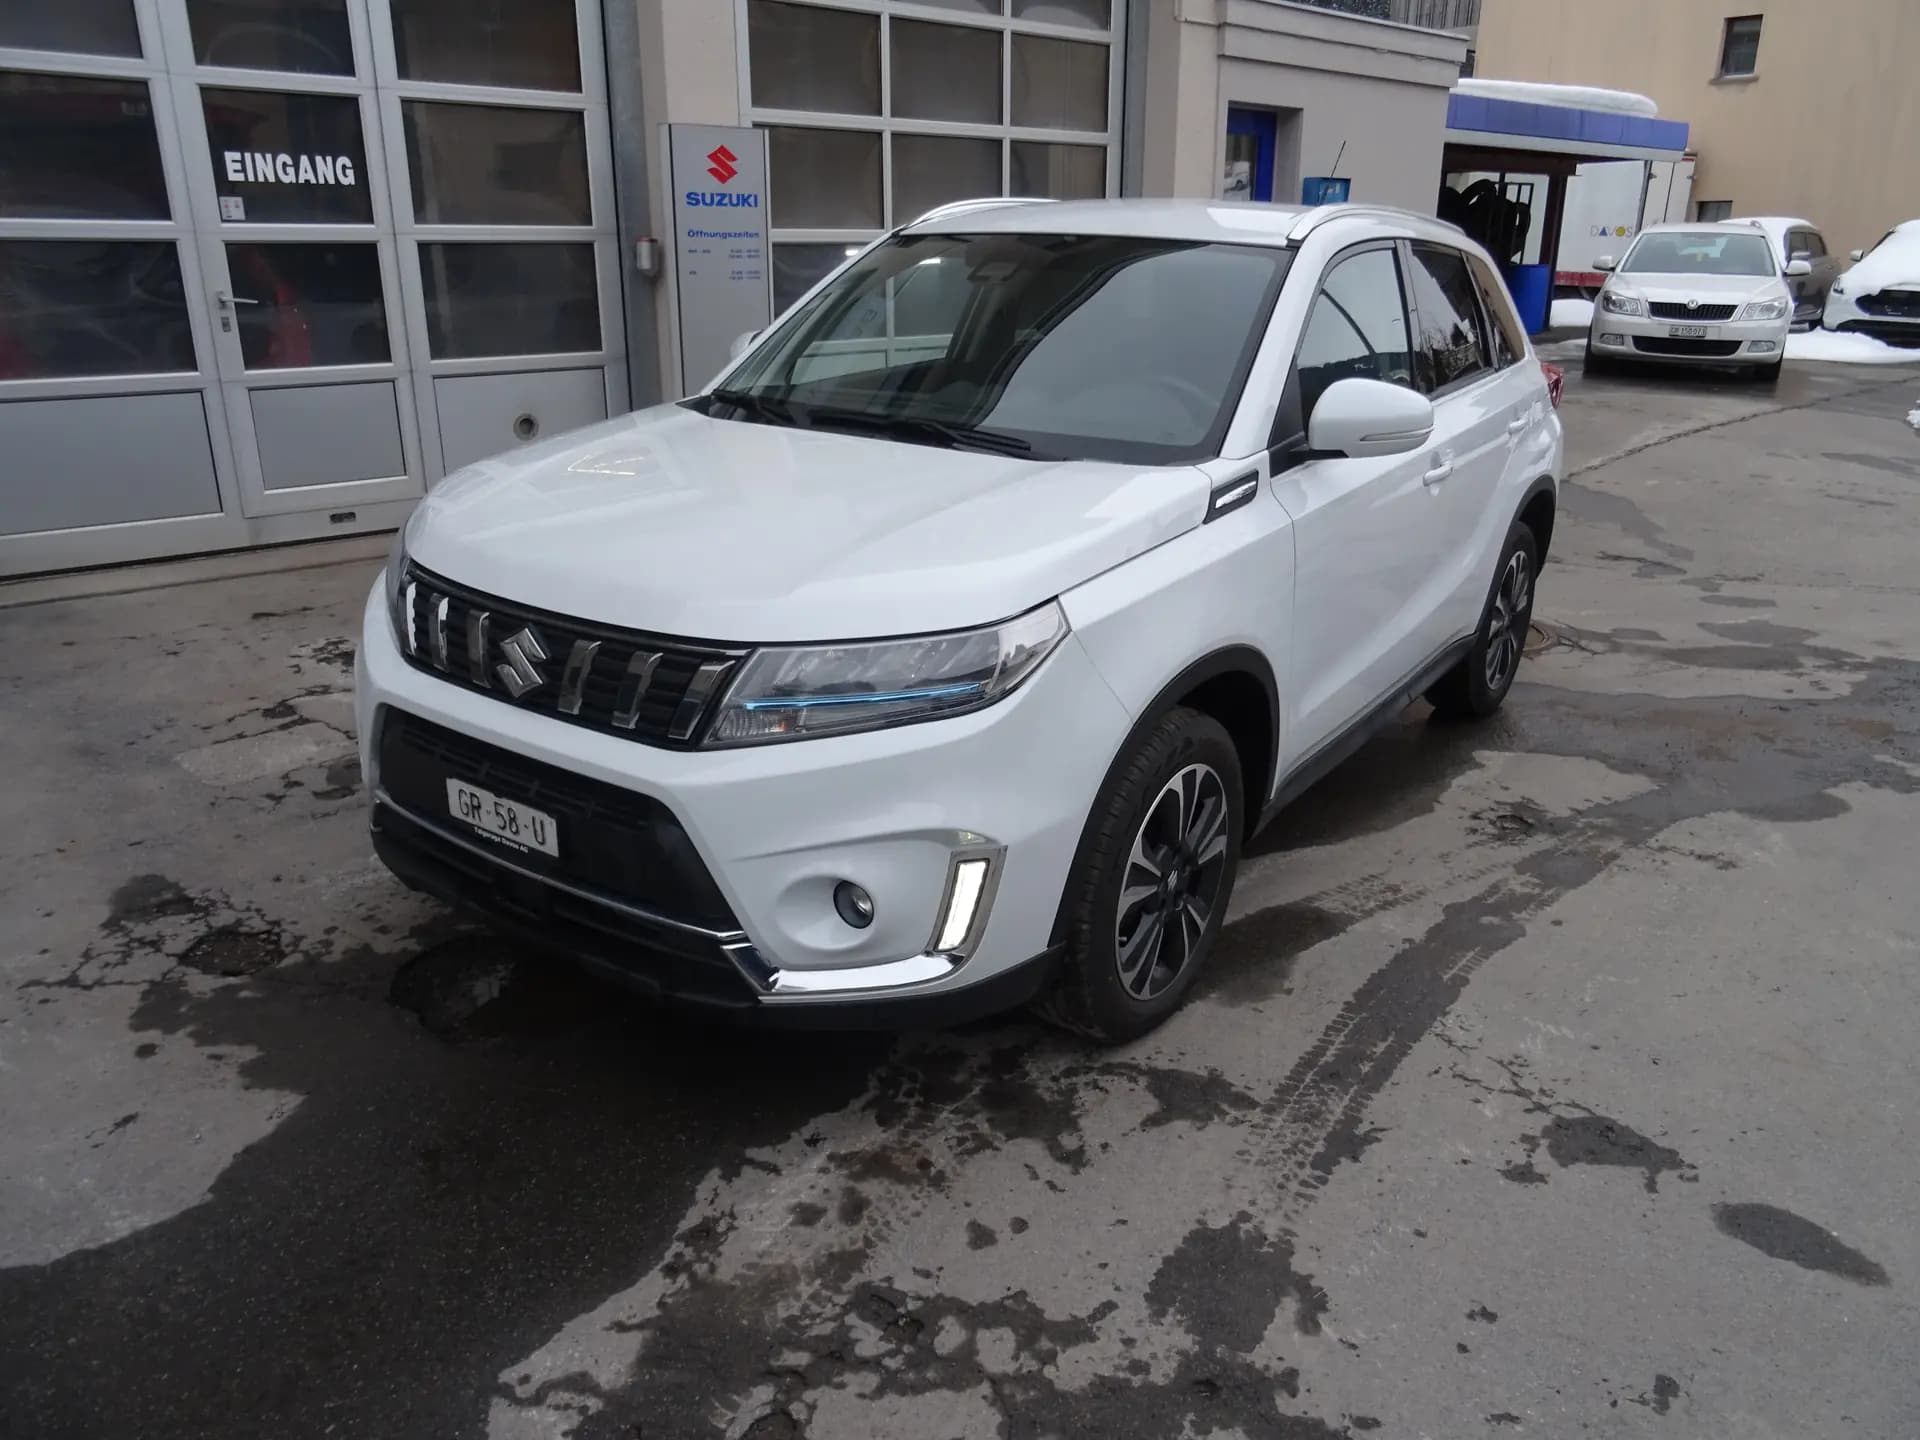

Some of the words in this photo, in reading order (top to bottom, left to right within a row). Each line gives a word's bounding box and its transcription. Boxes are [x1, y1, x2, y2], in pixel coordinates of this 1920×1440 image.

[224, 151, 356, 185] EINGANG
[685, 191, 759, 208] SUZUKI
[687, 228, 760, 240] Öffnungszeiten
[1591, 225, 1633, 238] DAVOS
